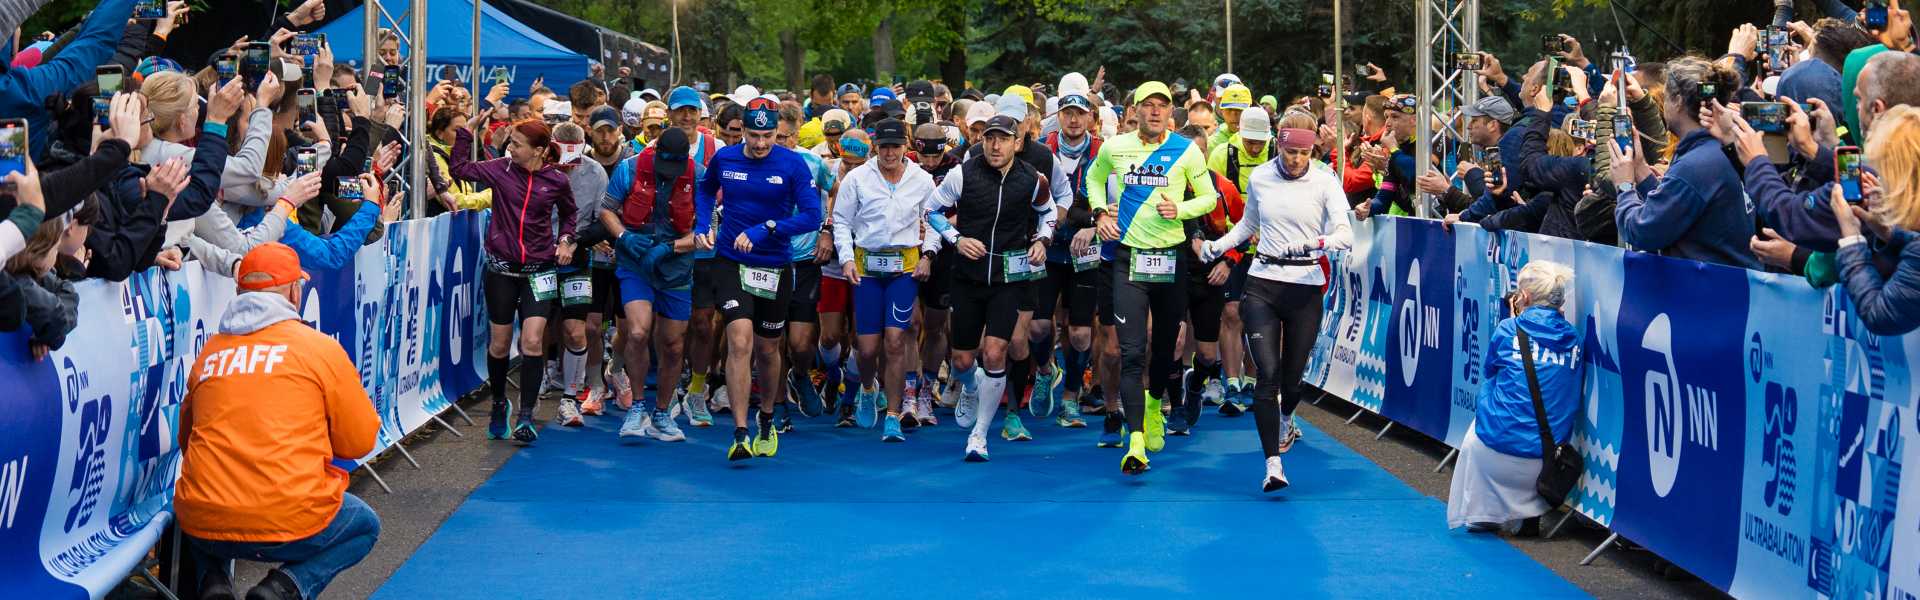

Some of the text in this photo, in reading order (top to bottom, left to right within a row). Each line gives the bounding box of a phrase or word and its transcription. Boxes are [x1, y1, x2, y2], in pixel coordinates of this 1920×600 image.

[877, 257, 888, 267] 33
[1146, 257, 1162, 267] 311
[572, 282, 583, 291] 67
[751, 271, 768, 283] 184
[1424, 305, 1440, 350] NN
[199, 344, 288, 381] STAFF
[1686, 383, 1718, 451] NN
[1744, 512, 1805, 568] ULTRABALATON
